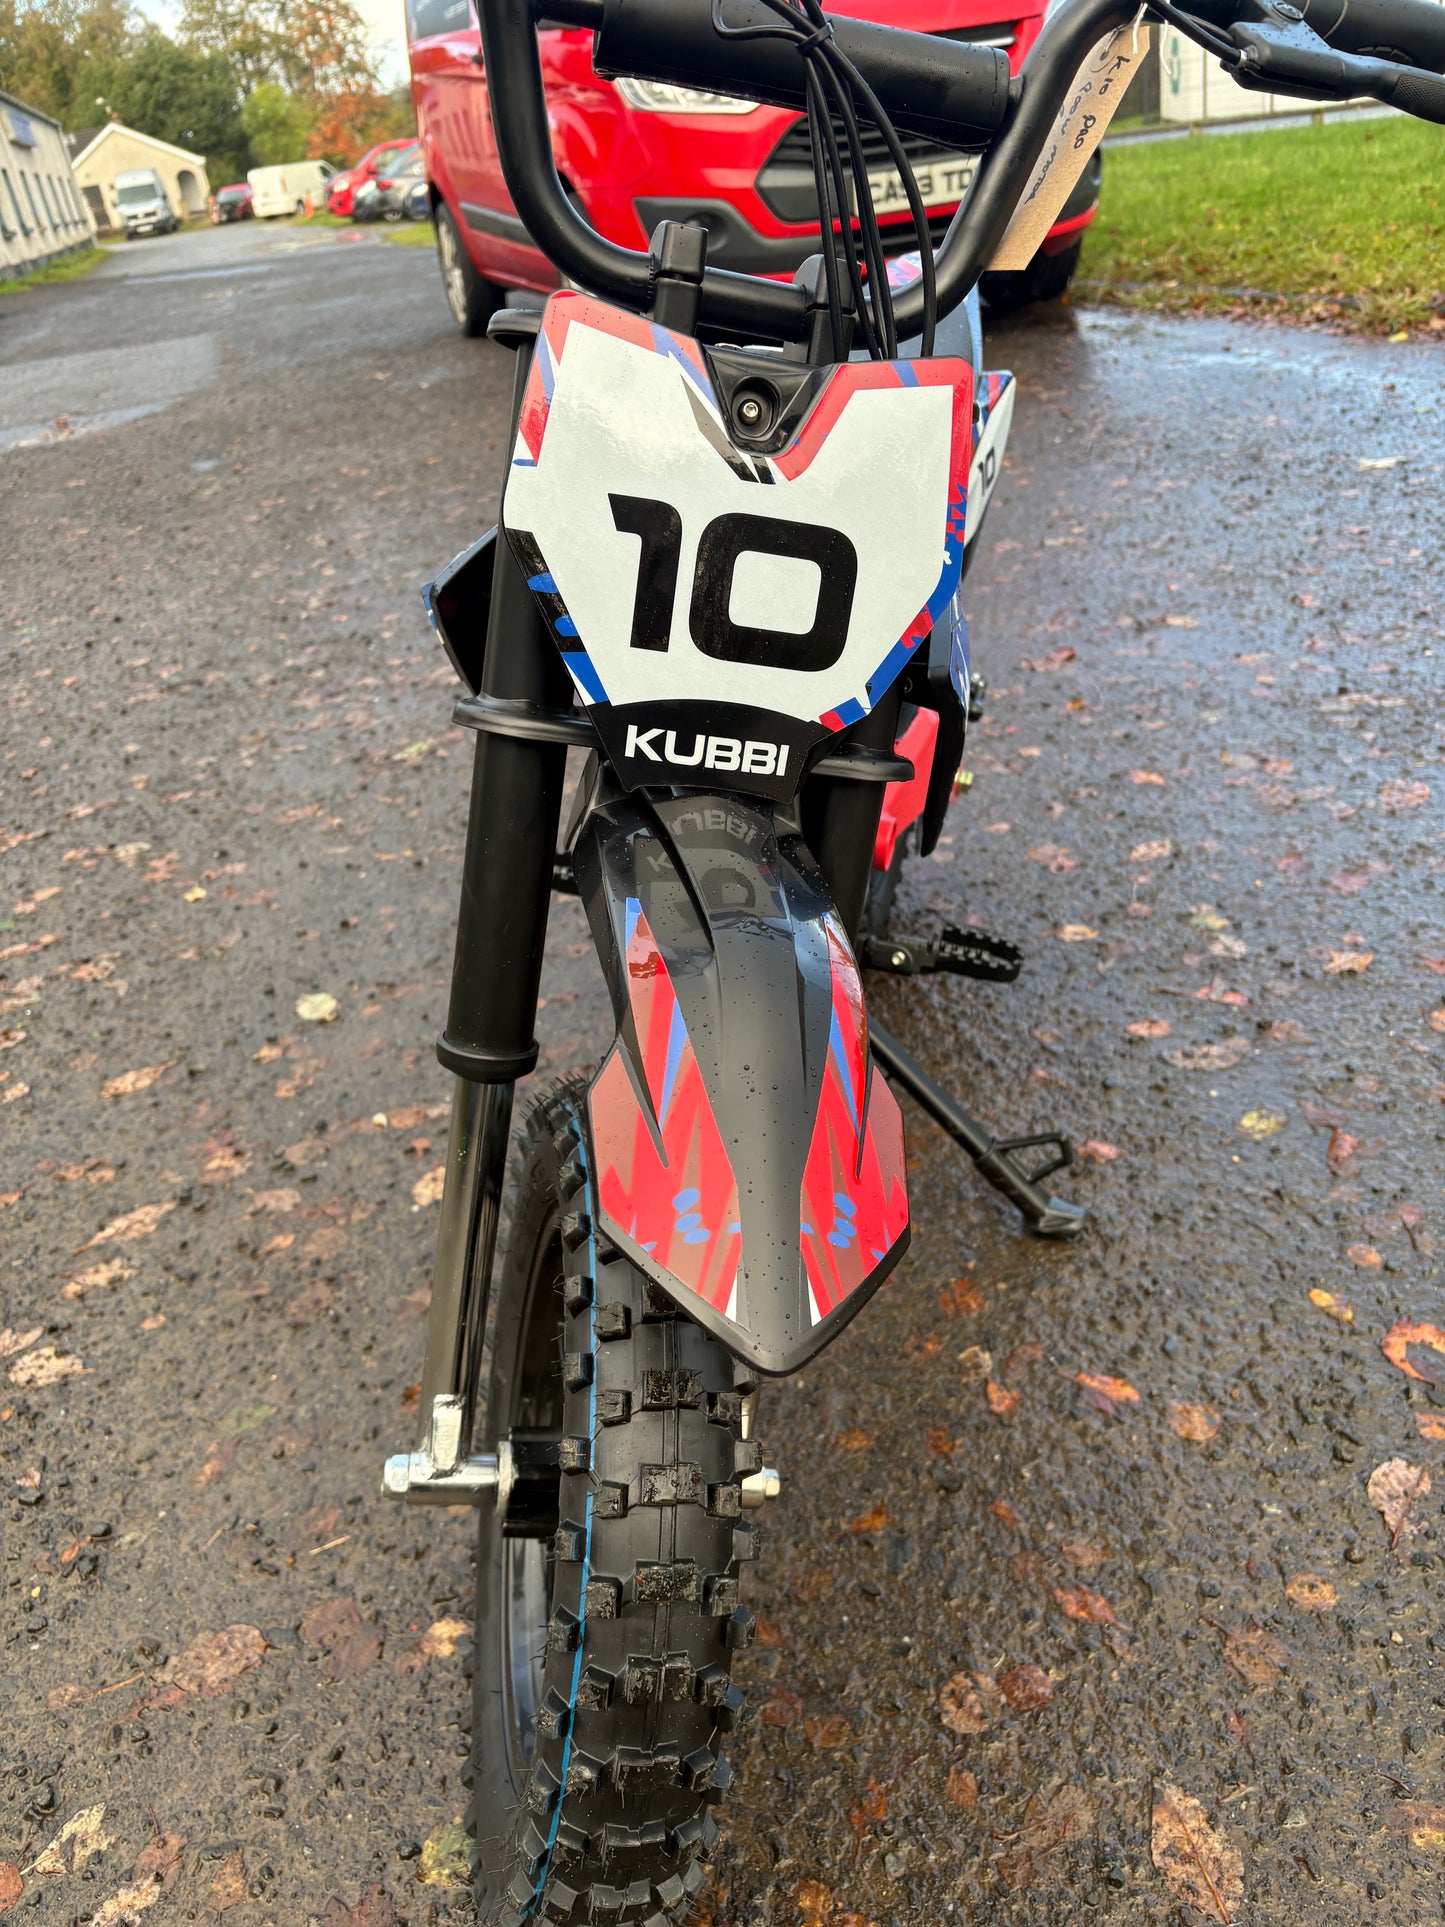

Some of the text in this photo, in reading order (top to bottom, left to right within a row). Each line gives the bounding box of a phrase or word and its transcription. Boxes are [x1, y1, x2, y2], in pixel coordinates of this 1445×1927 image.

[977, 445, 995, 498] 10
[608, 492, 858, 673] 10
[624, 724, 790, 778] KUBBI
